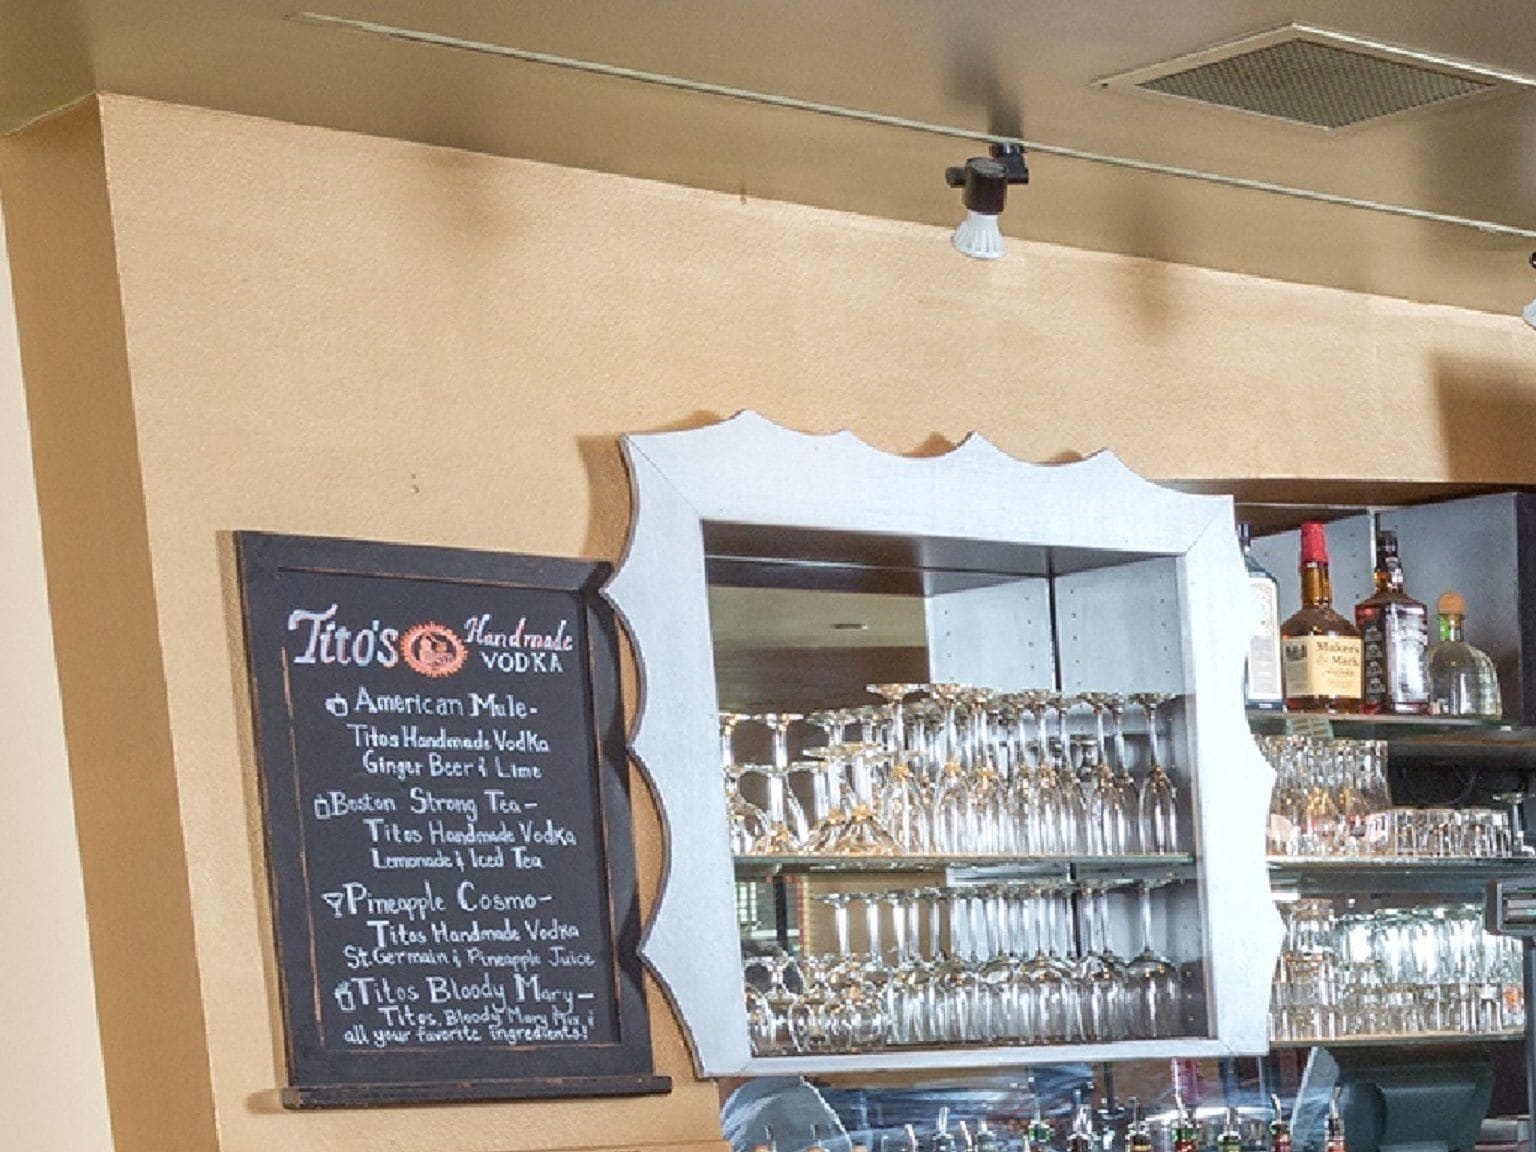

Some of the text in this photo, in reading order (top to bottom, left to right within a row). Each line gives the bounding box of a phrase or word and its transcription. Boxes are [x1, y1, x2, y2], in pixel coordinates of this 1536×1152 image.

[288, 604, 573, 668] Tito's Handmade
[481, 652, 563, 673] VODKA
[355, 687, 463, 717] American
[402, 725, 492, 751] Handmade
[362, 750, 424, 781] Ginger
[429, 752, 474, 777] Beer
[494, 756, 543, 778] Lime
[328, 788, 396, 816] Boston
[409, 787, 478, 821] Strong
[363, 818, 423, 842] Titos
[428, 819, 515, 845] Handmade
[369, 847, 452, 869] Lemonade
[467, 846, 504, 868] Iced
[510, 846, 544, 869] Tea
[342, 879, 446, 920] Pineapple
[367, 920, 427, 947] Titos
[431, 918, 521, 943] Handmade
[467, 946, 541, 972] Pineapple
[547, 945, 595, 968] Juice
[351, 976, 420, 1005] Titos
[426, 972, 507, 1014] Bloody
[443, 1004, 502, 1028] Bloody
[507, 1006, 549, 1028] Mary
[344, 1024, 369, 1045] all
[372, 1028, 412, 1048] your
[416, 1025, 482, 1043] favorite
